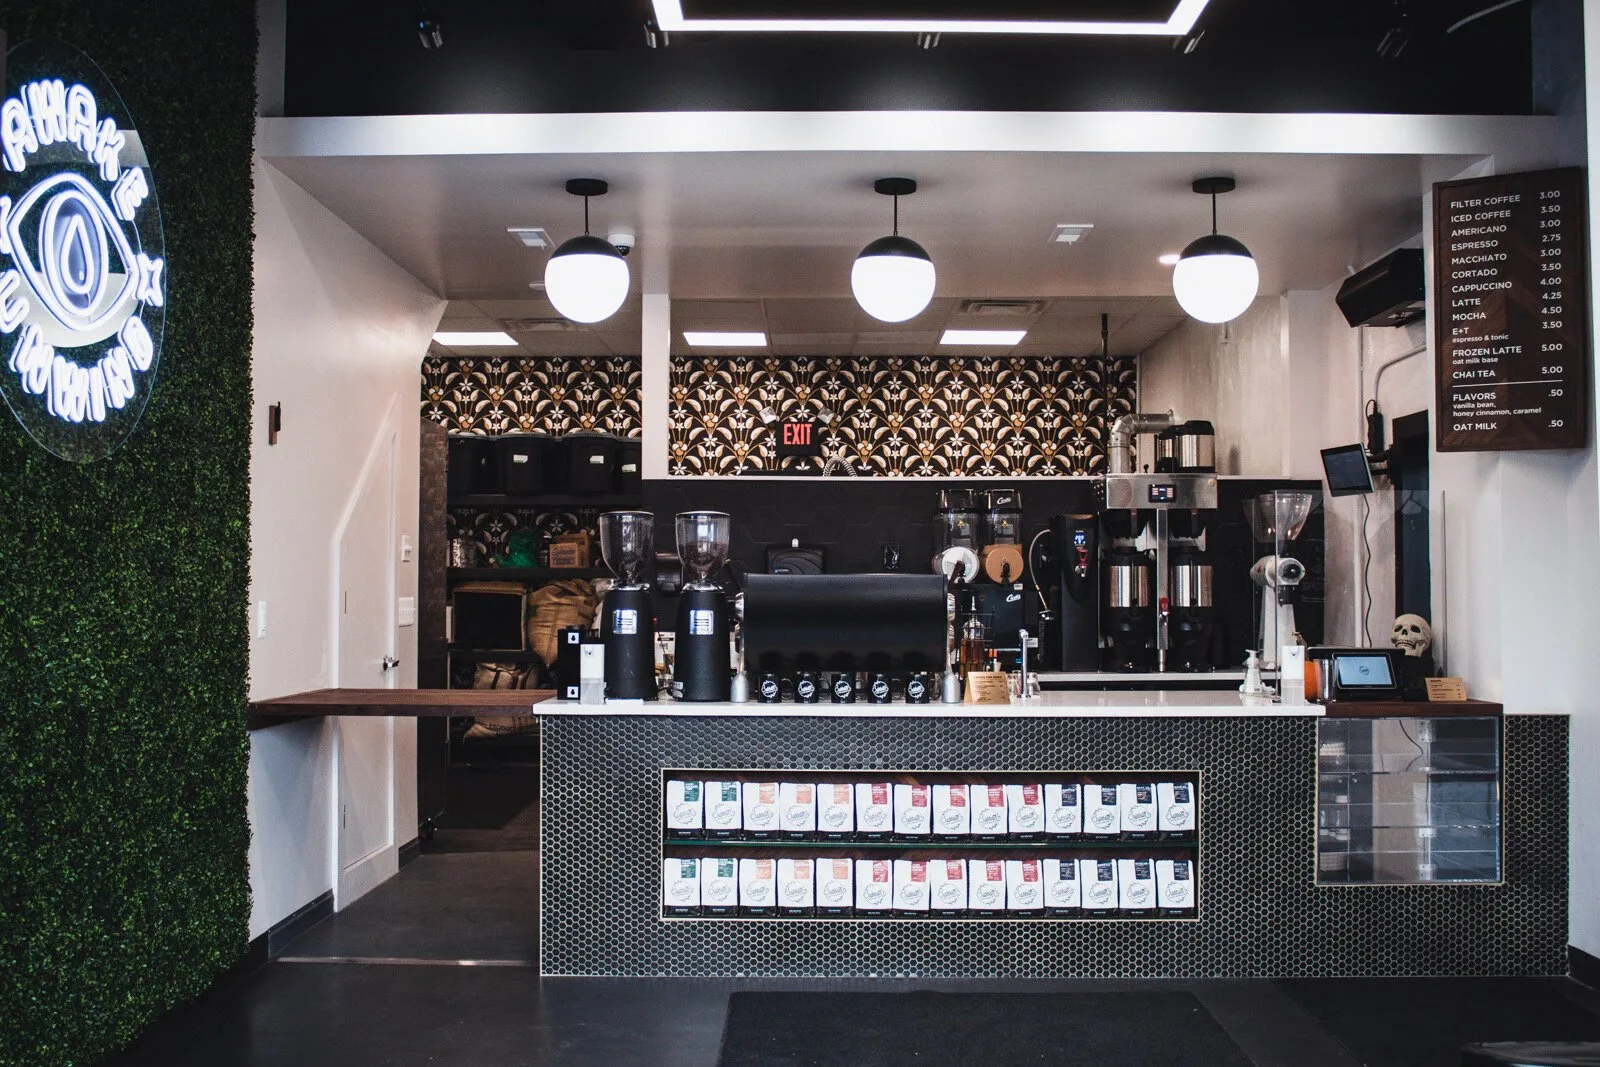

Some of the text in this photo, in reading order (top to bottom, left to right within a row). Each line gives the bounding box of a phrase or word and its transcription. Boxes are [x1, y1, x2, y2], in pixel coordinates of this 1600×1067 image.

[1, 78, 149, 221] AWAKE
[1450, 190, 1561, 209] FILTER COFFEE 3.00
[1450, 205, 1561, 223] ICED COFFEE 3.50
[1451, 219, 1561, 237] AMERICANO 3.00
[1451, 234, 1561, 251] ESPRESSO 2.75
[1451, 248, 1561, 265] MACCHIATO 3.00
[1451, 263, 1562, 279] CORTADO 3.50
[1451, 277, 1562, 293] CAPPUCCINO 4.00
[1452, 292, 1562, 307] LATTE 4.25
[1452, 306, 1562, 321] MOCHA 4.50
[1452, 321, 1562, 336] E+T 3.50
[1452, 336, 1483, 344] espresso
[1452, 343, 1563, 357] FROZEN LATTE 5.00
[1452, 366, 1563, 379] CHAI TEA 5.00
[1453, 389, 1563, 401] FLAVORS .50
[1475, 408, 1512, 416] cinnamon,
[1513, 407, 1542, 415] caramel
[1453, 420, 1563, 431] OAT MILK .50
[783, 423, 813, 445] EXIT
